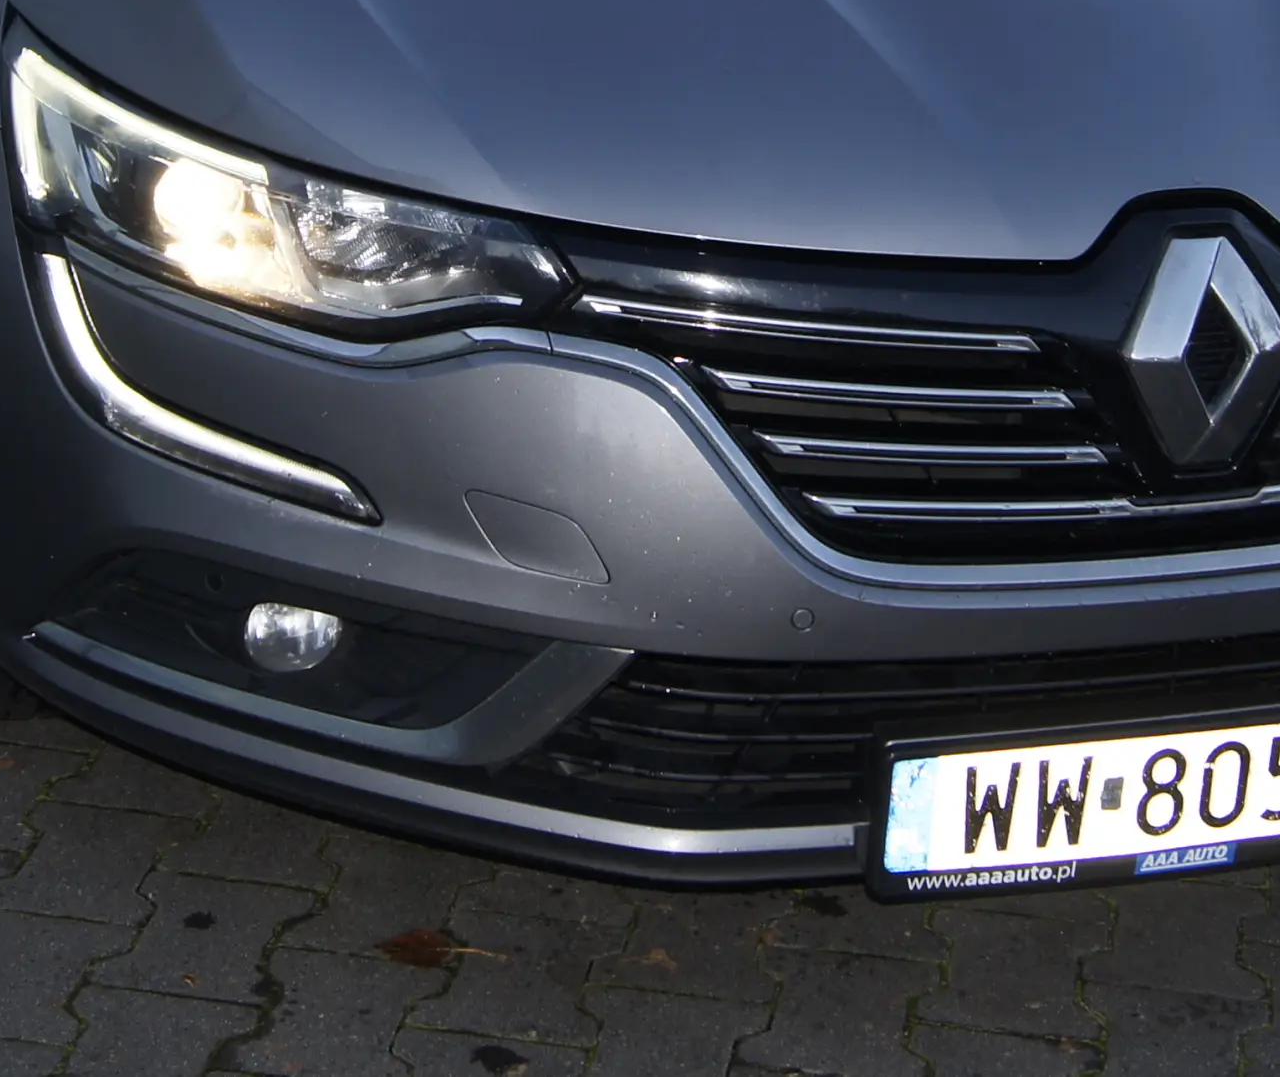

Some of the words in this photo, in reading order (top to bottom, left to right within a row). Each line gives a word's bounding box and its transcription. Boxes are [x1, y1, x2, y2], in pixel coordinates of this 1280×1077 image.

[964, 755, 1093, 854] WW
[1140, 851, 1179, 869] AAA
[1182, 845, 1228, 863] AUTO
[907, 861, 1077, 891] www.aaaauto.pl
